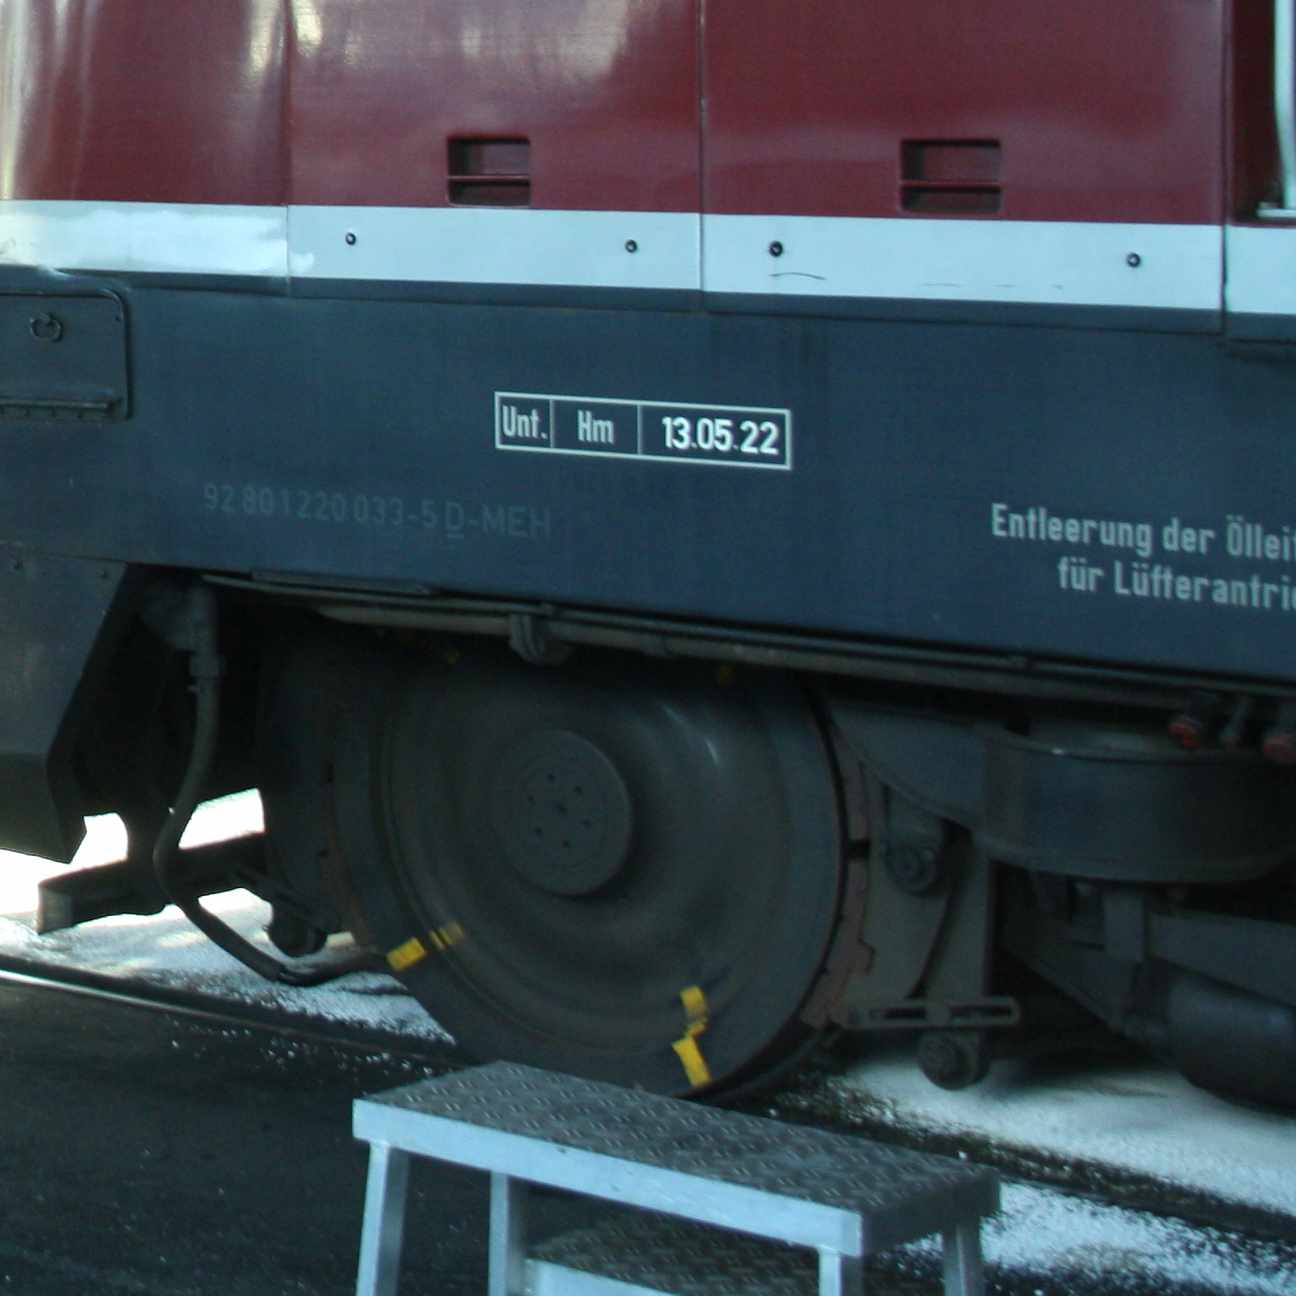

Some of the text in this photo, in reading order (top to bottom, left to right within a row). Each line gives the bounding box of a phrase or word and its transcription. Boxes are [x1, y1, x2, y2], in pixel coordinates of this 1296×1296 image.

[501, 405, 780, 456] Unt. Hm 13.05.22
[991, 502, 1153, 558] Entleerung
[1162, 517, 1216, 555] der
[1058, 555, 1104, 592] für
